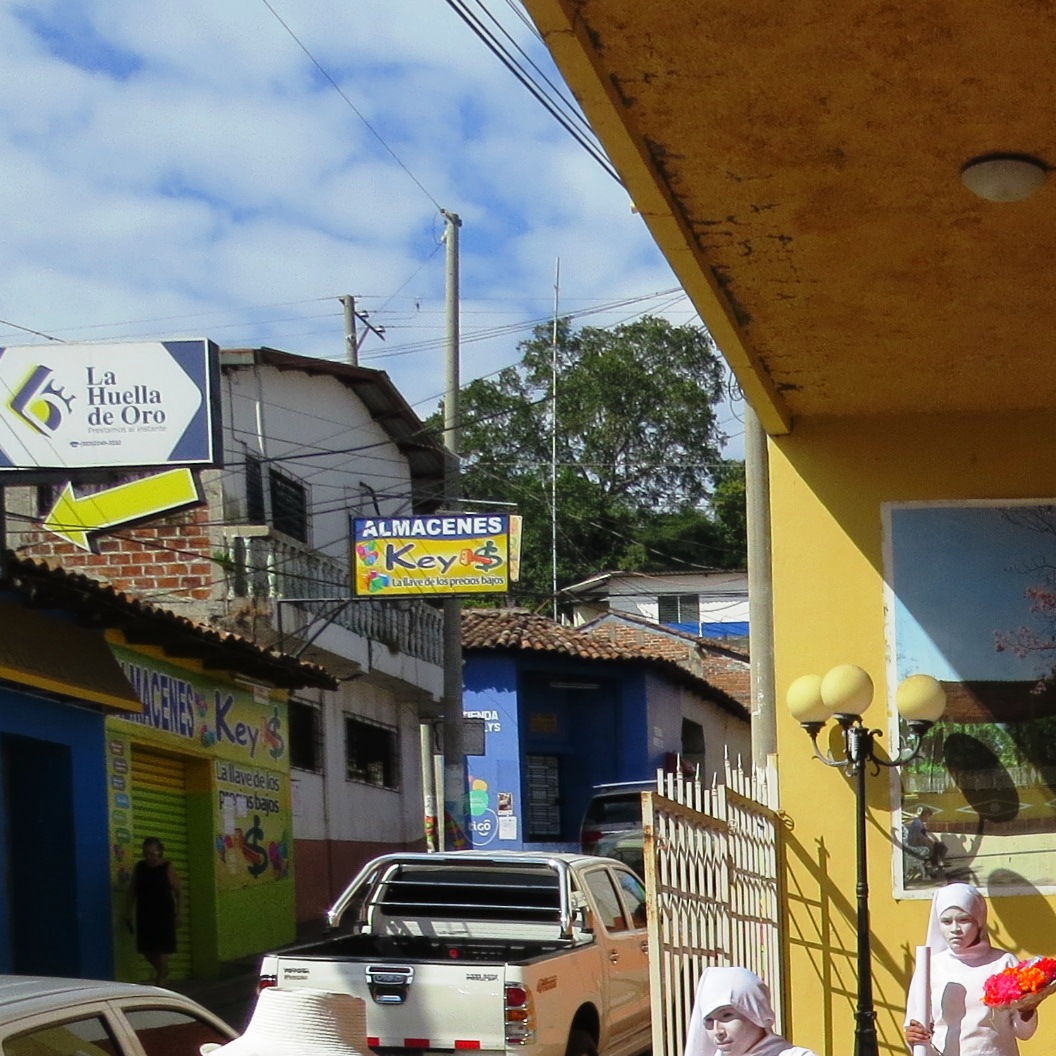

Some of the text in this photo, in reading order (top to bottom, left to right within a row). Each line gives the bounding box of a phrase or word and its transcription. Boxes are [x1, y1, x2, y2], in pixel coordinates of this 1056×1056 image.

[86, 366, 116, 386] La
[87, 385, 161, 406] Huella
[88, 405, 166, 426] de Oro
[362, 516, 502, 538] ALMACENES
[385, 543, 457, 574] Key
[392, 575, 504, 589] La llave de los precios bajos
[215, 689, 260, 760] Key
[216, 761, 280, 792] La llave de los
[255, 792, 280, 817] bajos
